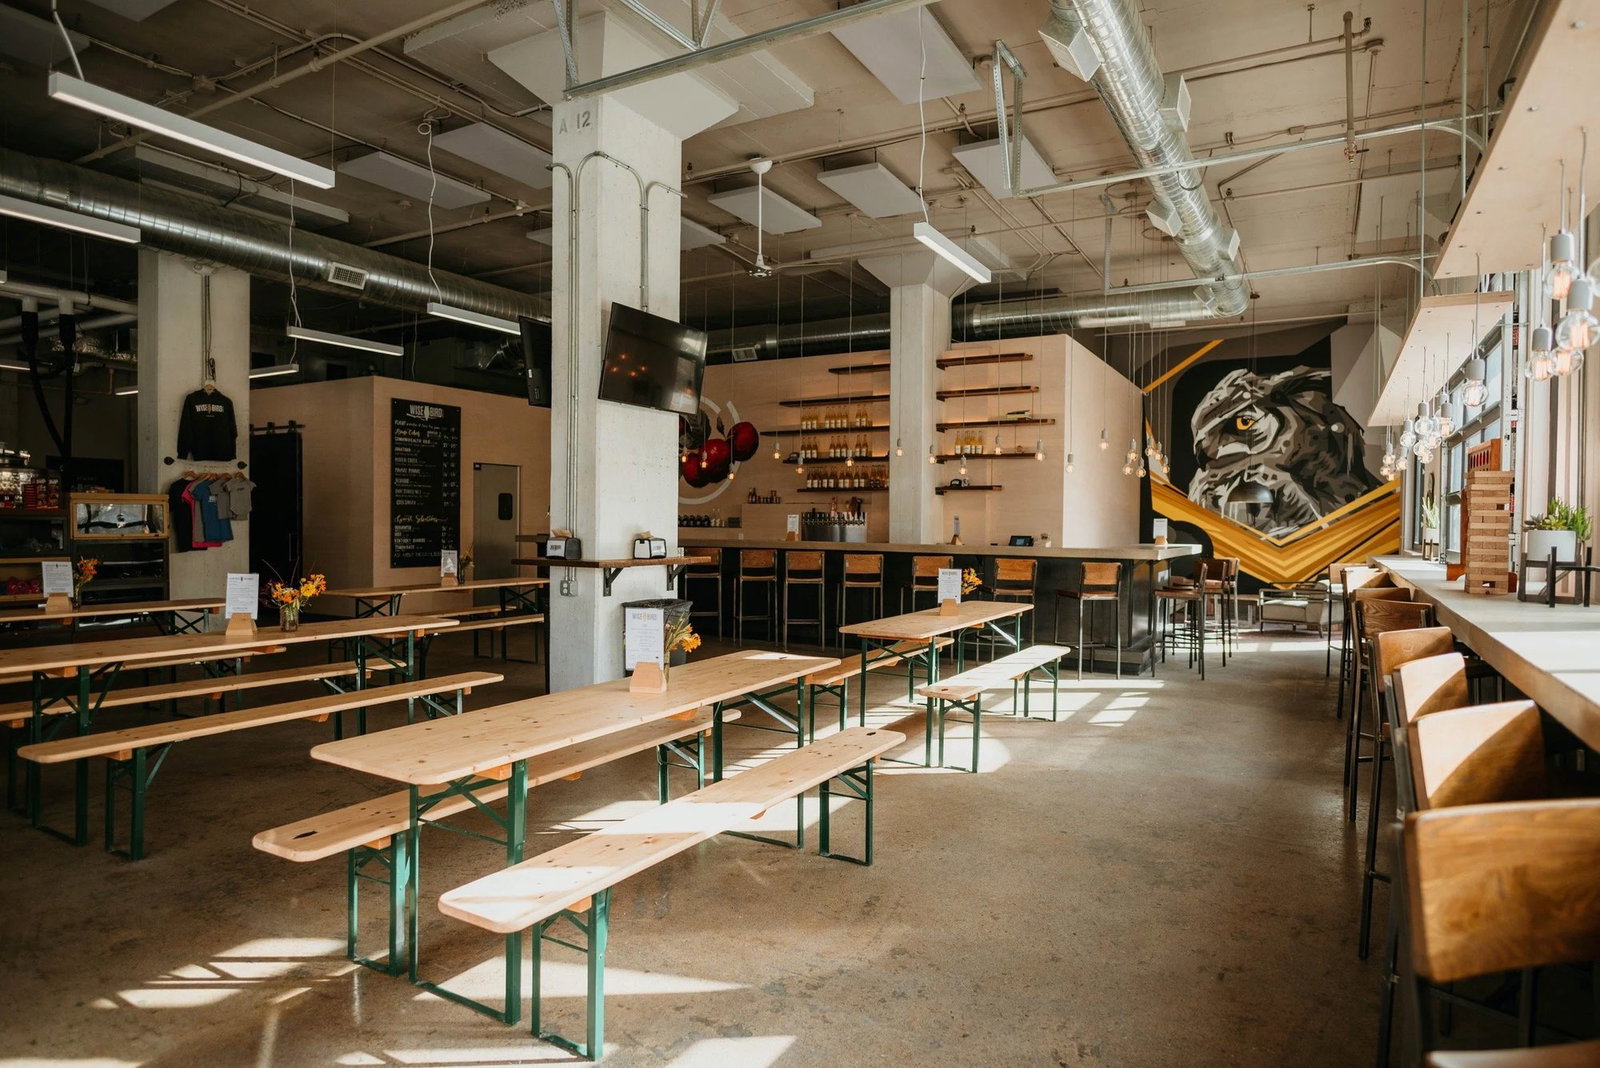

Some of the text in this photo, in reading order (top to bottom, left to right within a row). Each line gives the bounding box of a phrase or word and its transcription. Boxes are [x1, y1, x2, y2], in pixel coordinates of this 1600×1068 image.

[559, 110, 591, 135] A 12
[409, 404, 443, 418] WISE BIRD
